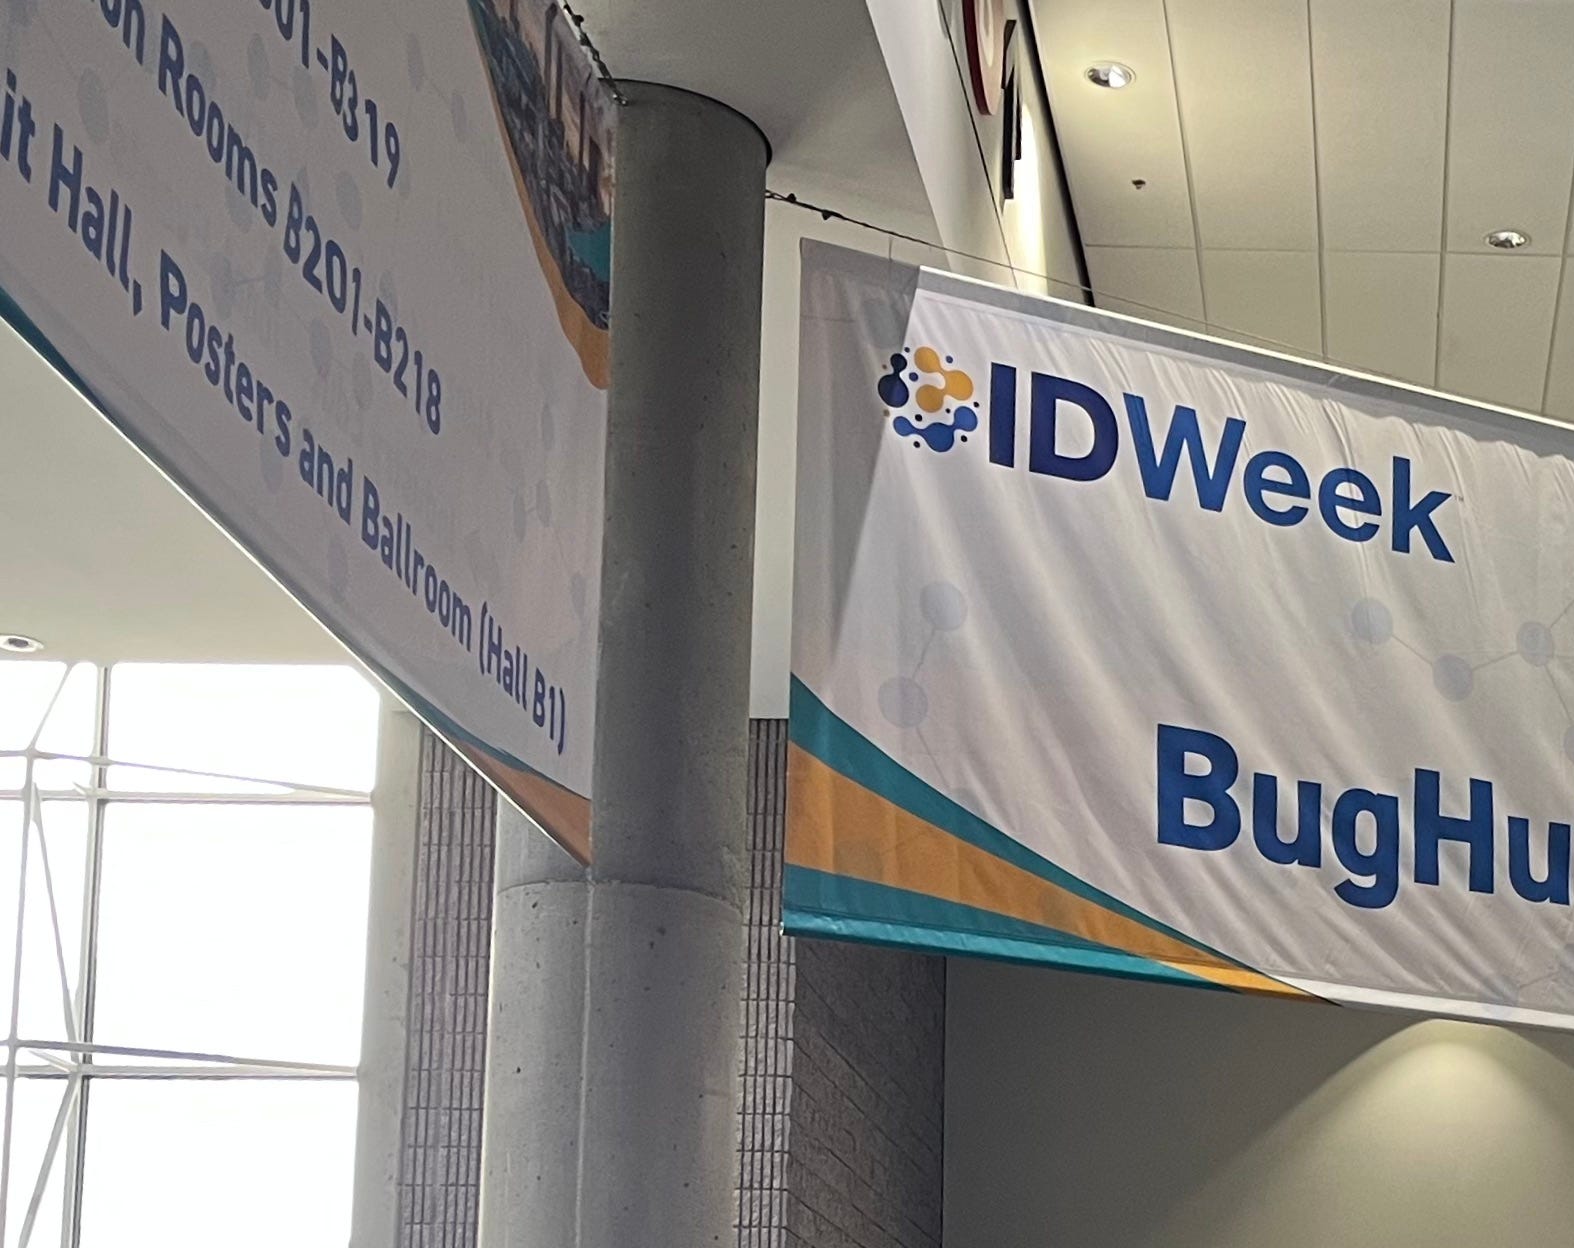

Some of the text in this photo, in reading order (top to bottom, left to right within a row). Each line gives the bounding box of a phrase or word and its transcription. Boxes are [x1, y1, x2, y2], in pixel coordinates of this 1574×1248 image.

[158, 13, 278, 228] Rooms
[284, 187, 443, 435] B201-B218
[258, 0, 400, 190] 01-B319
[0, 68, 566, 756] it Hall, Posters and Ballroom (Hall B1)
[988, 361, 1456, 564] IDWeek
